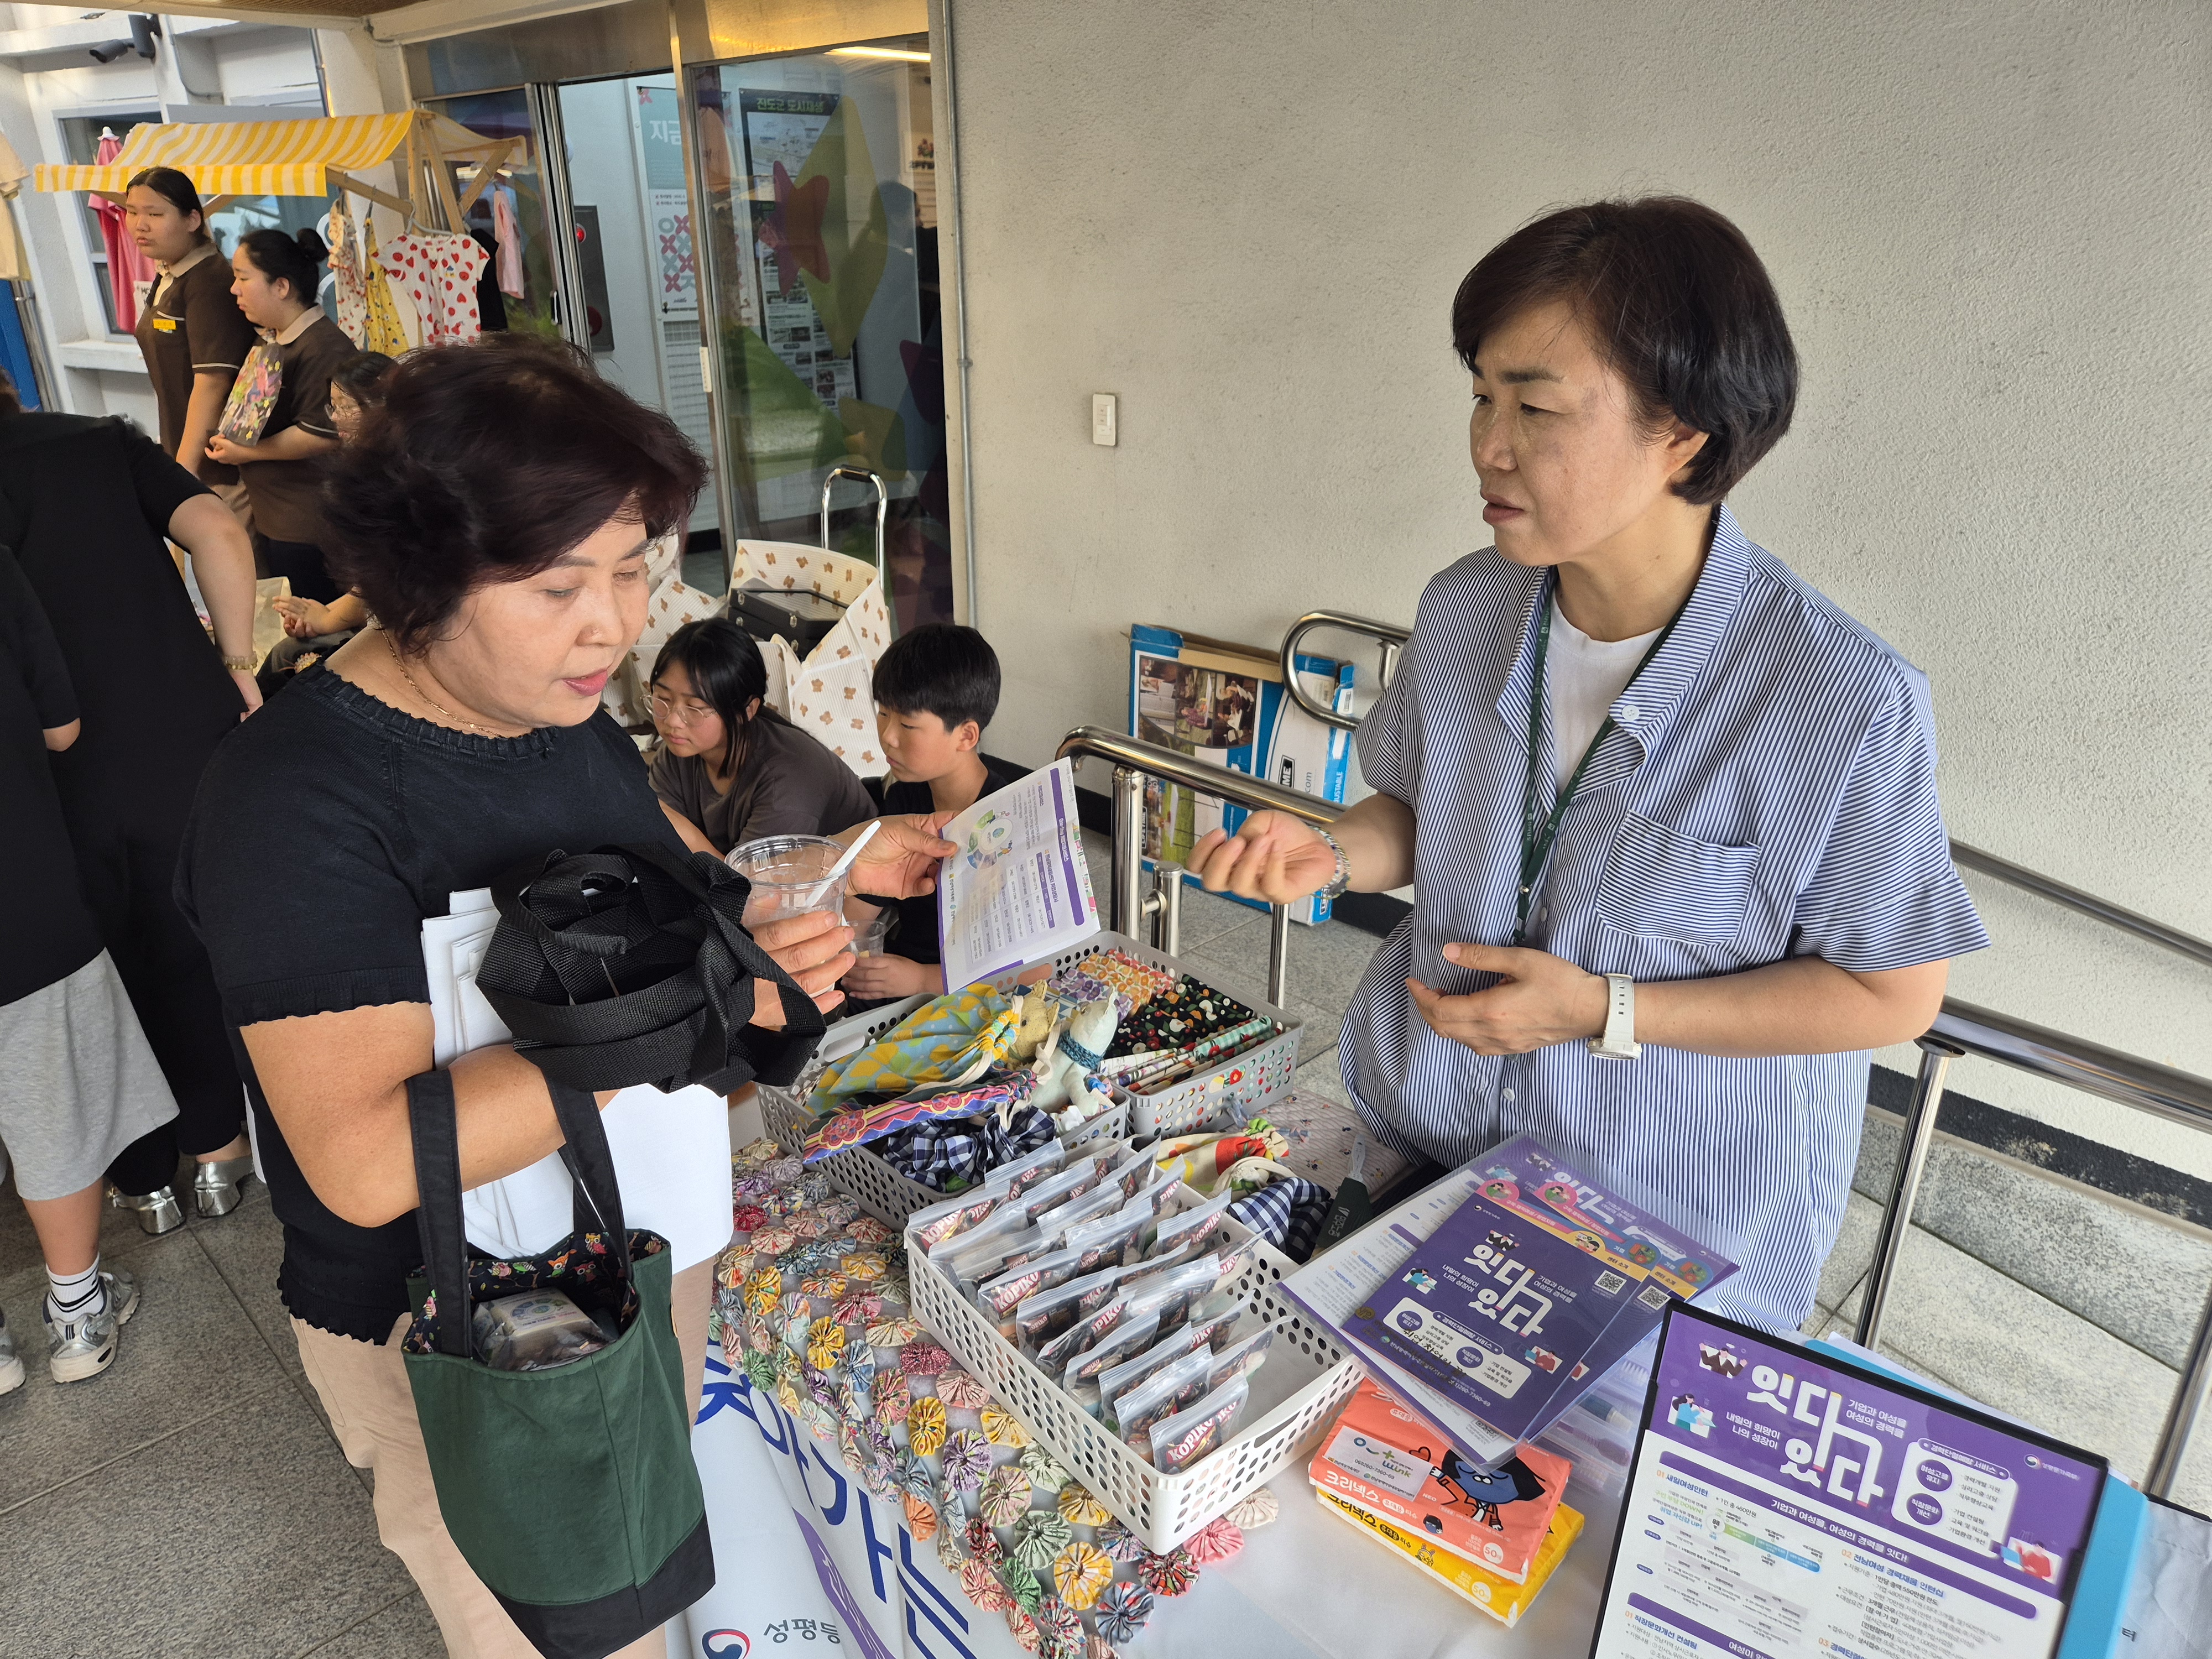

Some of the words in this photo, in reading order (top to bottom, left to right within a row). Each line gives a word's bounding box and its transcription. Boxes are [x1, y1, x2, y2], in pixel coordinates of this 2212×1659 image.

[757, 98, 784, 111] 진도군
[1282, 767, 1292, 788] ME
[1334, 771, 1343, 802] JUSTABLE
[1442, 1264, 1461, 1277] 내일의
[1460, 1274, 1479, 1288] 희망이
[1618, 1260, 1629, 1270] 소개
[996, 1271, 1039, 1310] KOPIKO
[1443, 1272, 1457, 1283] 나의
[1455, 1280, 1475, 1293] 성장이
[1533, 1280, 1553, 1293] 여성의
[1538, 1275, 1558, 1288] 기업과
[1468, 1288, 1547, 1338] 있다
[1846, 1410, 1874, 1427] 여성의
[1876, 1421, 1905, 1439] 경력을
[1848, 1399, 1877, 1416] 기업과
[1878, 1410, 1907, 1428] 여성을
[1726, 1412, 1752, 1428] 내일의
[1753, 1423, 1780, 1440] 희망이
[1731, 1425, 1750, 1438] 나의
[1751, 1433, 1778, 1449] 성장이
[1168, 1417, 1214, 1460] KOPIKO
[1383, 1460, 1412, 1478] wink
[1780, 1438, 1884, 1508] 있다
[1974, 1460, 1997, 1475] 서비스
[1324, 1471, 1380, 1503] 크리넥스
[1384, 1500, 1404, 1513] 휴대용
[1405, 1509, 1417, 1519] 티슈
[1422, 1493, 1437, 1501] NEO
[1666, 1474, 1708, 1497] 새일여성인턴
[1679, 1500, 1704, 1515] DOWN!
[1327, 1493, 1377, 1527] 크리넥스
[1380, 1525, 1399, 1540] 휴대용
[1400, 1538, 1411, 1548] 티슈
[1691, 1520, 1703, 1530] UP!
[1771, 1499, 1797, 1516] 기업과
[1798, 1510, 1827, 1530] 여성을,
[1829, 1523, 1856, 1541] 여성의
[1858, 1535, 1885, 1554] 경력을
[1886, 1547, 1908, 1563] 잇다!
[1841, 1549, 1852, 1559] 02
[1854, 1553, 1885, 1573] 전남여성
[1920, 1582, 1944, 1598] 인턴십
[1875, 1575, 1889, 1585] 1인당
[1902, 1586, 1926, 1600] 550만원
[764, 1618, 841, 1644] 성평등
[1634, 1614, 1674, 1639] 직장문화개선
[1676, 1634, 1698, 1650] 컨설팅
[1818, 1637, 1830, 1647] 03
[1728, 1641, 1754, 1658] 여성이
